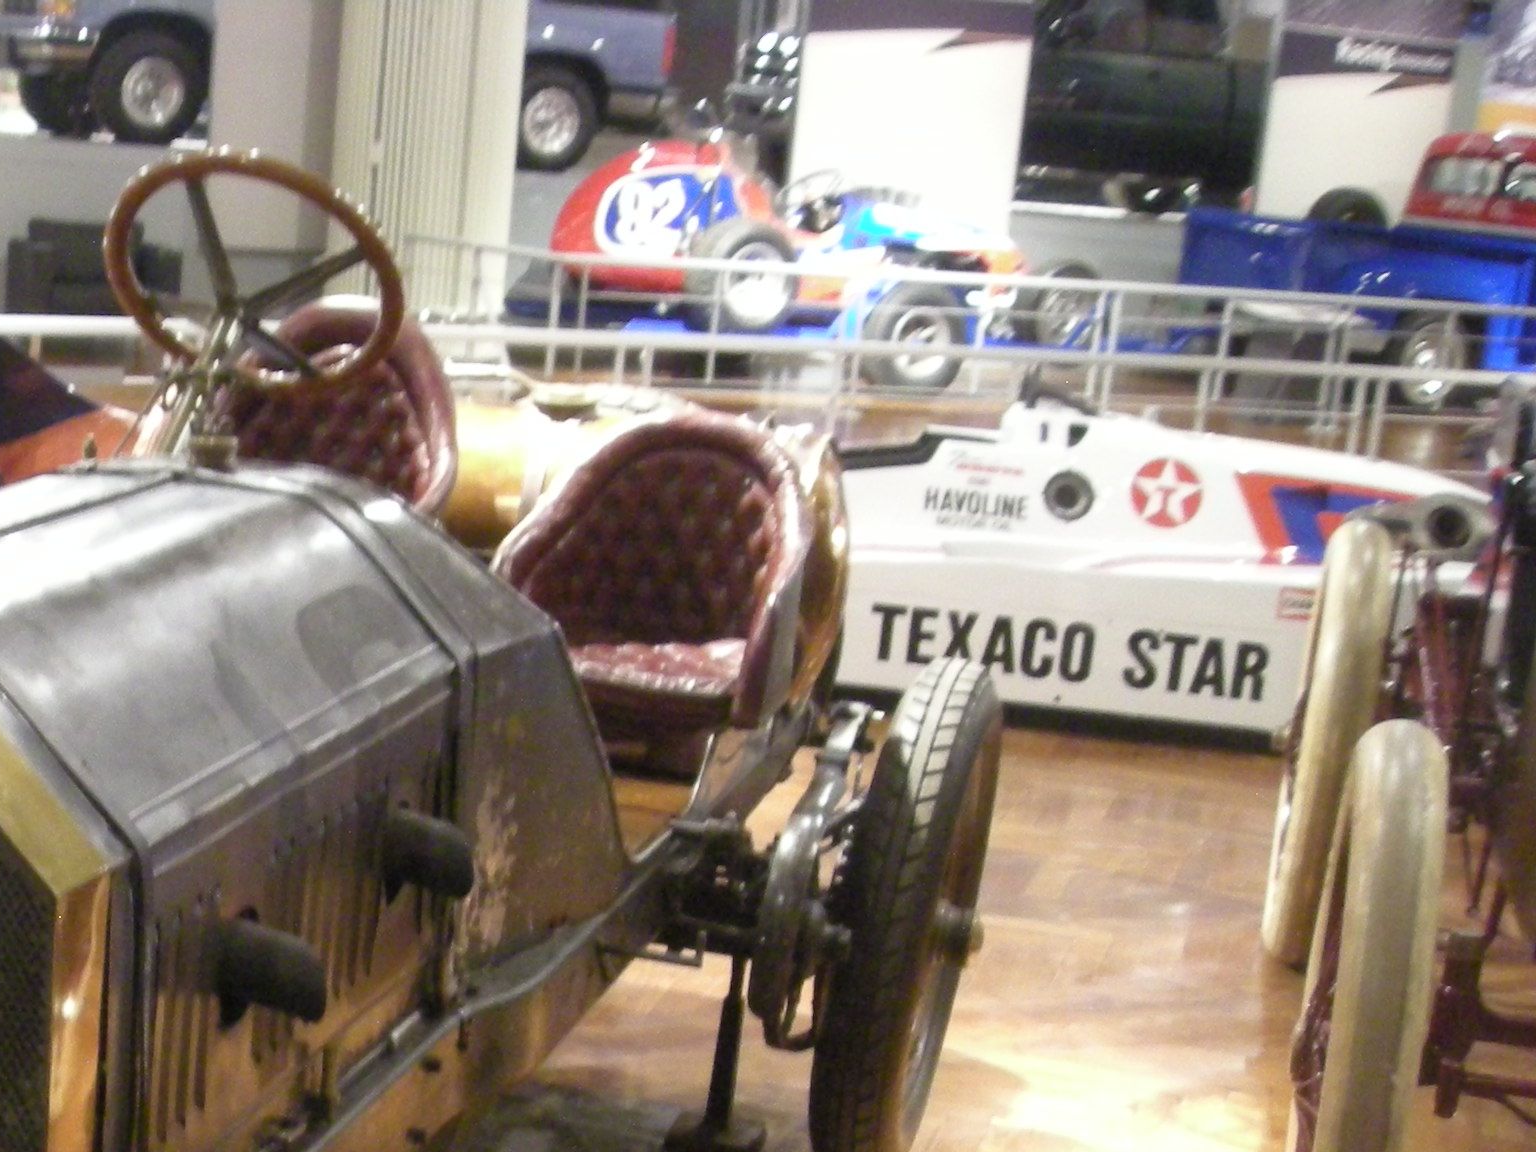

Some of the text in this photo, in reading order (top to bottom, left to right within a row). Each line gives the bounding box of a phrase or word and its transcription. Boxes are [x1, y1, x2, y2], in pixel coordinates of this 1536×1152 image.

[923, 485, 1029, 520] HAVOLINE
[870, 602, 1269, 704] TEXACO STAR
